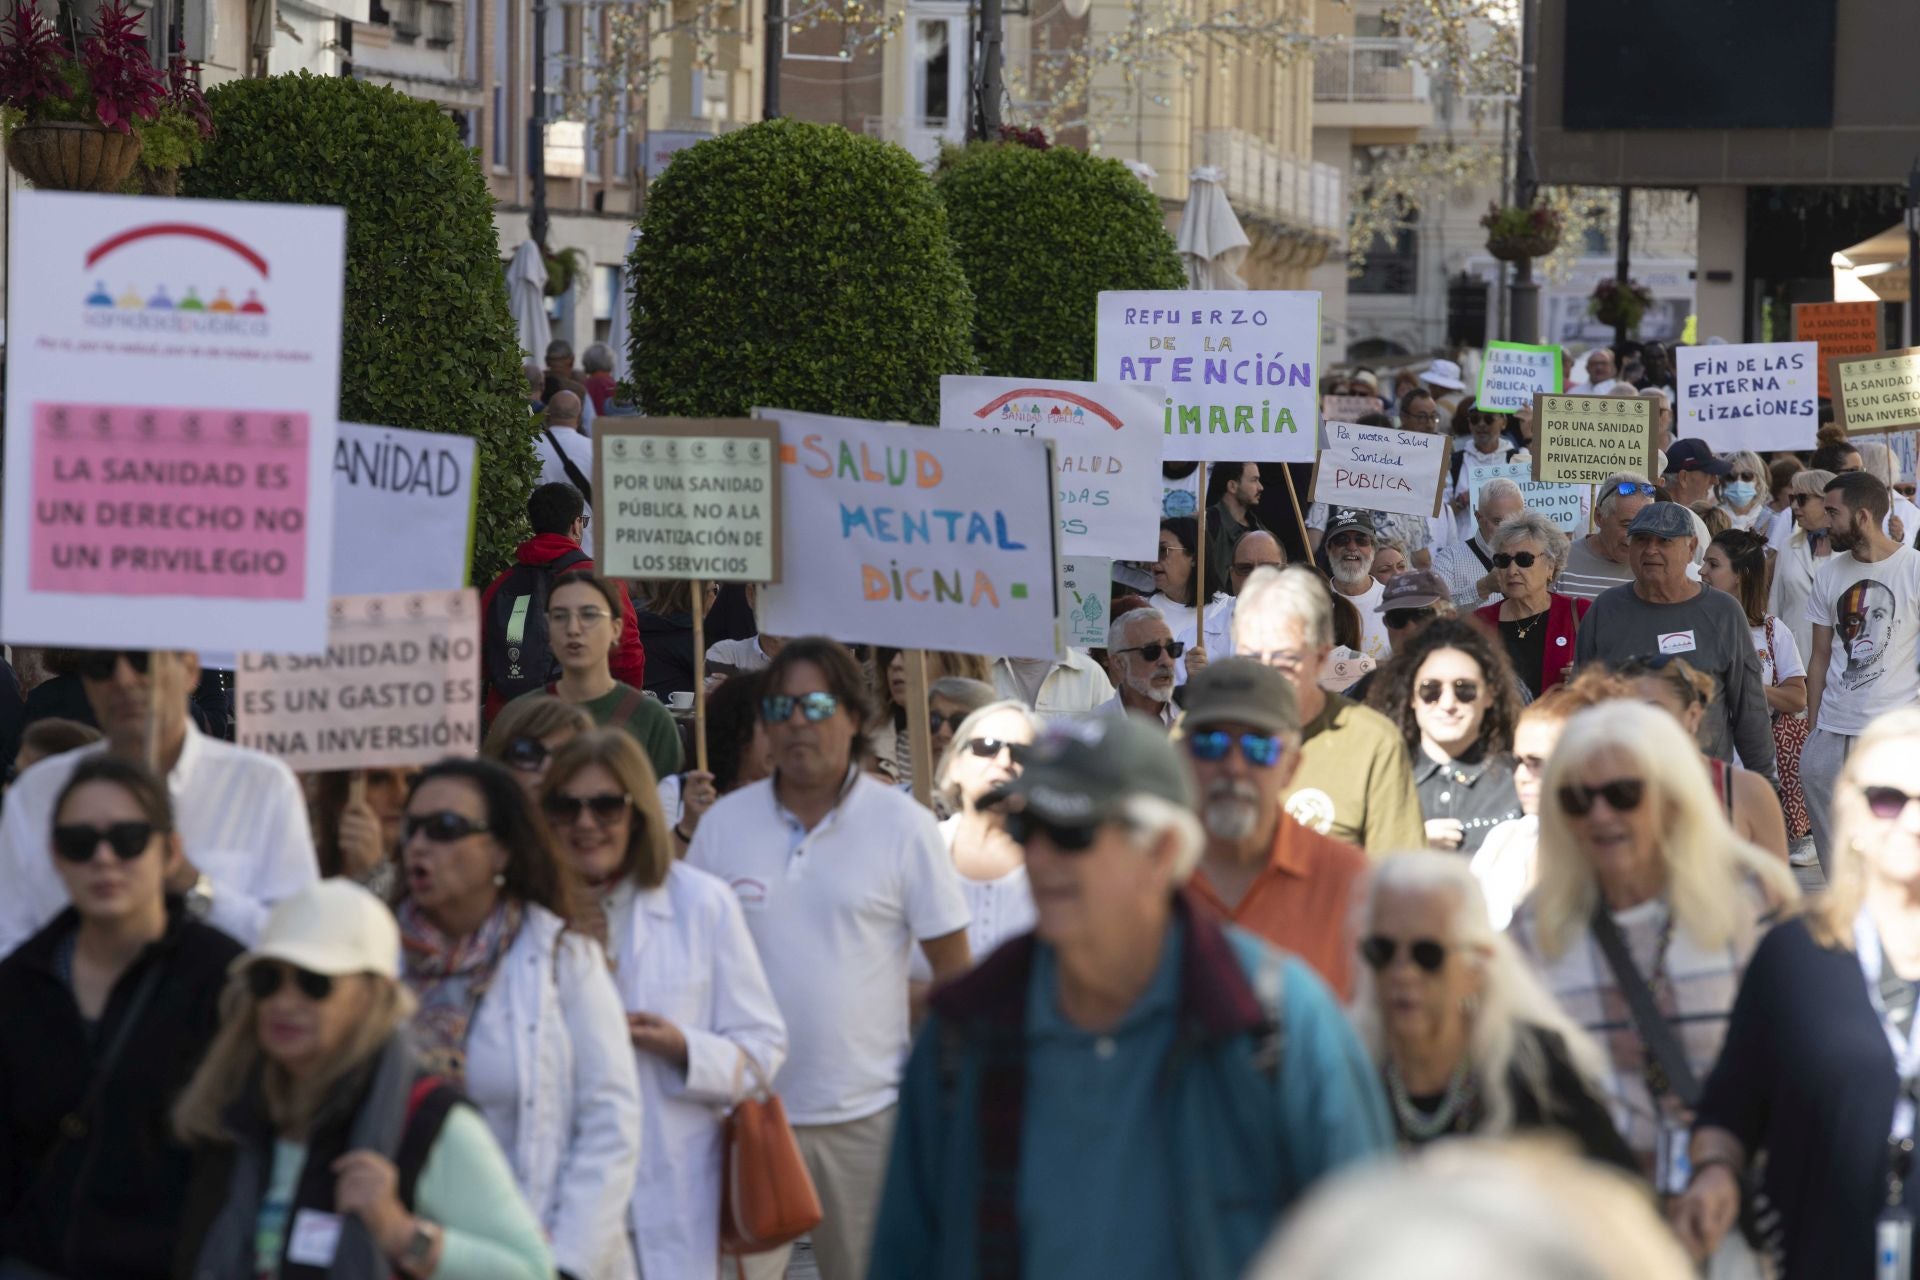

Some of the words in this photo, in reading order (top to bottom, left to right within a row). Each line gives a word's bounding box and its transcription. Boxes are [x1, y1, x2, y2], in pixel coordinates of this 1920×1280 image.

[1125, 308, 1268, 326] REFUERZO
[1803, 320, 1816, 329] LA
[1817, 319, 1858, 328] SANIDAD
[1861, 319, 1872, 327] ES
[1149, 336, 1176, 351] DE
[1203, 336, 1233, 353] LA
[1861, 331, 1876, 340] NO
[1119, 352, 1312, 387] ATENCIÓN
[1492, 365, 1536, 378] SANIDAD
[1694, 357, 1728, 377] FIN
[1737, 358, 1756, 372] DE
[1764, 353, 1804, 371] LAS
[1530, 384, 1544, 393] LA
[1688, 376, 1780, 398] EXTERNA
[1844, 381, 1859, 392] LA
[1861, 375, 1913, 391] SANIDAD
[1846, 398, 1859, 408] ES
[1862, 396, 1879, 407] UN
[1882, 391, 1920, 404] GASTO
[1001, 411, 1042, 423] SANIDAD
[1164, 398, 1298, 434] IMARIA
[1698, 398, 1814, 422] LIZACIONES
[1848, 411, 1874, 424] UNA
[1876, 407, 1920, 422] INVERS
[1547, 420, 1569, 431] POR
[1572, 421, 1595, 432] UNA
[1597, 422, 1644, 434] SANIDAD
[1398, 432, 1429, 449] Salud
[1550, 435, 1596, 448] PÚBLICA.
[1599, 438, 1616, 449] NO
[1618, 439, 1625, 449] A
[1628, 439, 1641, 450] LA
[333, 433, 461, 498] ANIDAD
[803, 434, 943, 489] SALUD
[1057, 456, 1123, 474] ALUD
[1350, 446, 1404, 467] Sanidad
[1547, 453, 1626, 466] PRIVATIZACIÓN
[1629, 456, 1643, 466] DE
[53, 457, 92, 483] LA
[102, 457, 247, 488] SANIDAD
[256, 463, 290, 490] ES
[1336, 468, 1413, 492] PUBLICA
[1557, 469, 1577, 480] LOS
[1579, 470, 1616, 481] SERVIC
[614, 473, 649, 490] POR
[653, 475, 685, 492] UNA
[688, 476, 764, 493] SANIDAD
[1519, 481, 1554, 492] IDAD
[1058, 488, 1110, 506] ODAS
[1559, 494, 1579, 506] NO
[37, 500, 85, 526] UN
[96, 502, 244, 531] DERECHO
[255, 507, 304, 534] NO
[693, 503, 723, 519] NO
[727, 504, 738, 520] A
[742, 504, 761, 520] LA
[840, 502, 1027, 551] MENTAL
[615, 527, 740, 547] PRIVATIZACIÓN
[744, 531, 764, 547] DE
[52, 545, 100, 570] UN
[111, 545, 288, 576] PRIVILEGIO
[633, 555, 665, 571] LOS
[668, 556, 748, 573] SERVICIOS
[242, 651, 279, 672] LA
[243, 690, 276, 714] ES
[284, 688, 330, 713] UN
[338, 681, 434, 709] GASTO
[443, 679, 473, 703] ES
[317, 716, 473, 752] INVERSIÓN
